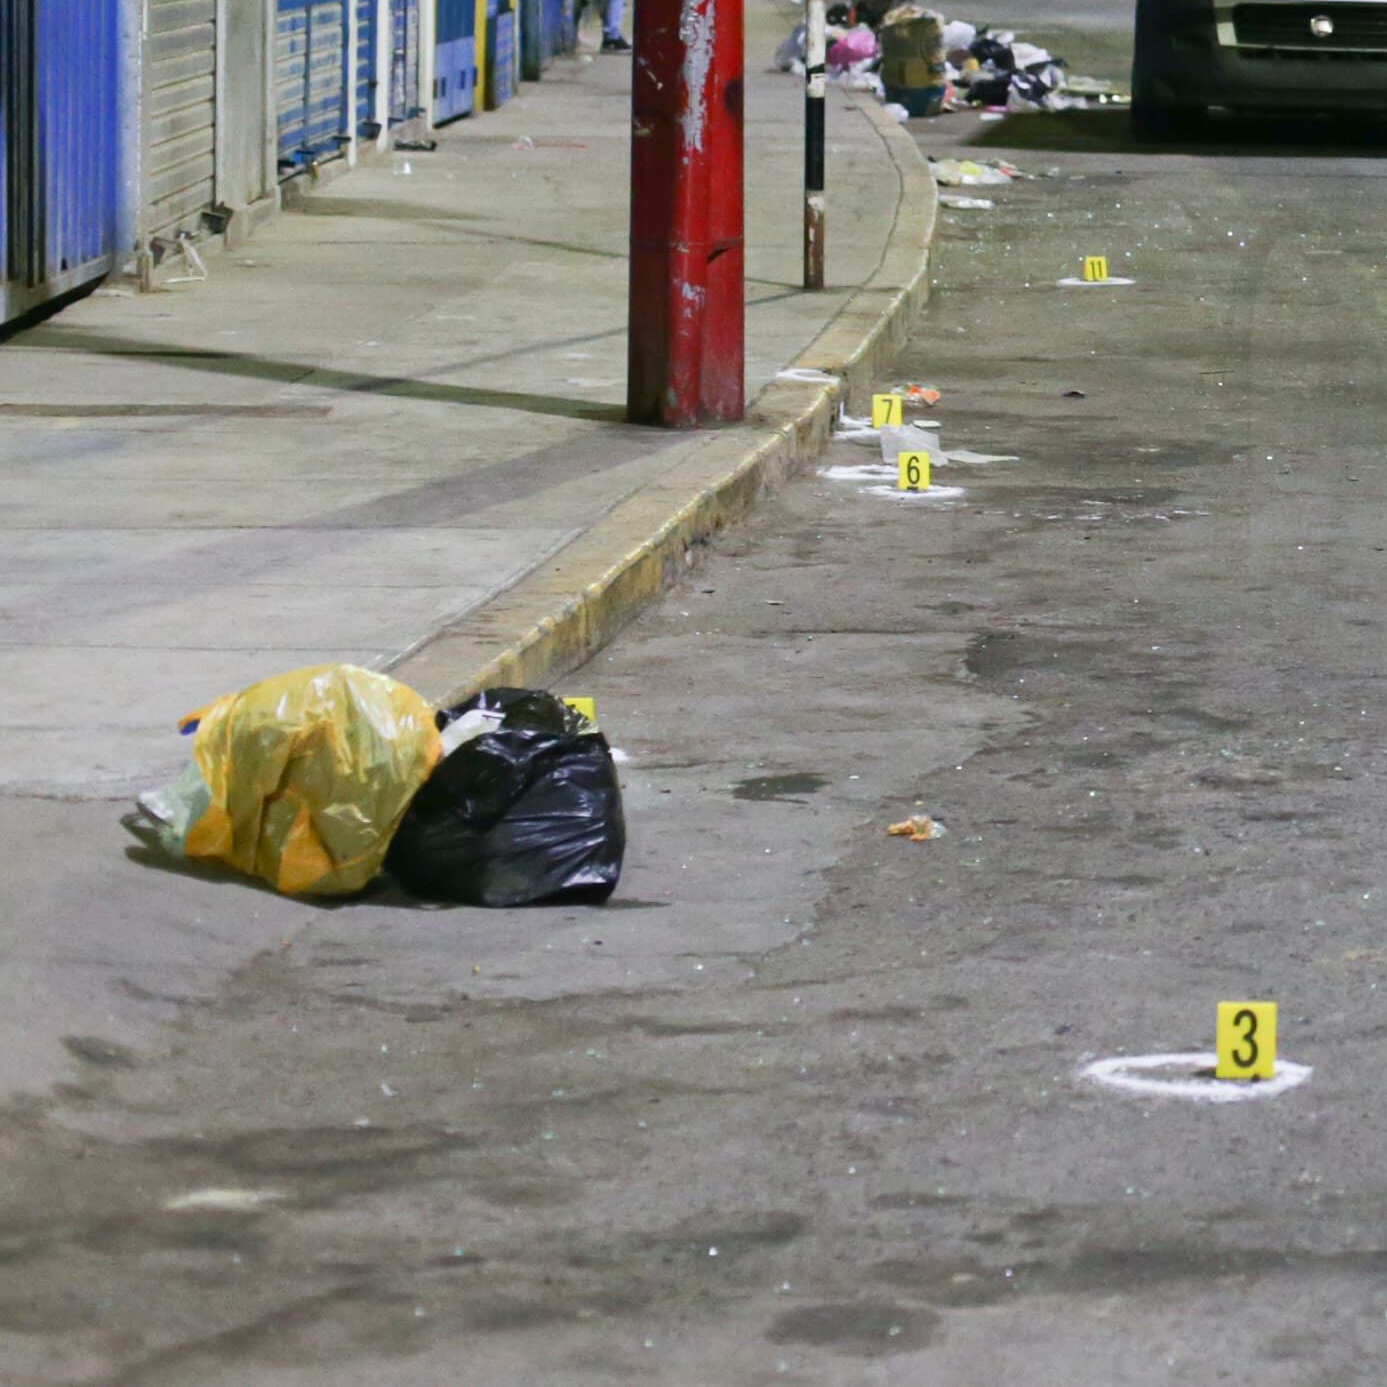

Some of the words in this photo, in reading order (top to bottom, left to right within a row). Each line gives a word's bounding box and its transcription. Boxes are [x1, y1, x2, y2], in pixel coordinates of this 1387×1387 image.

[1089, 260, 1103, 279] 11
[881, 398, 894, 426] 7
[906, 455, 921, 485] 6
[1231, 1008, 1259, 1069] 3
